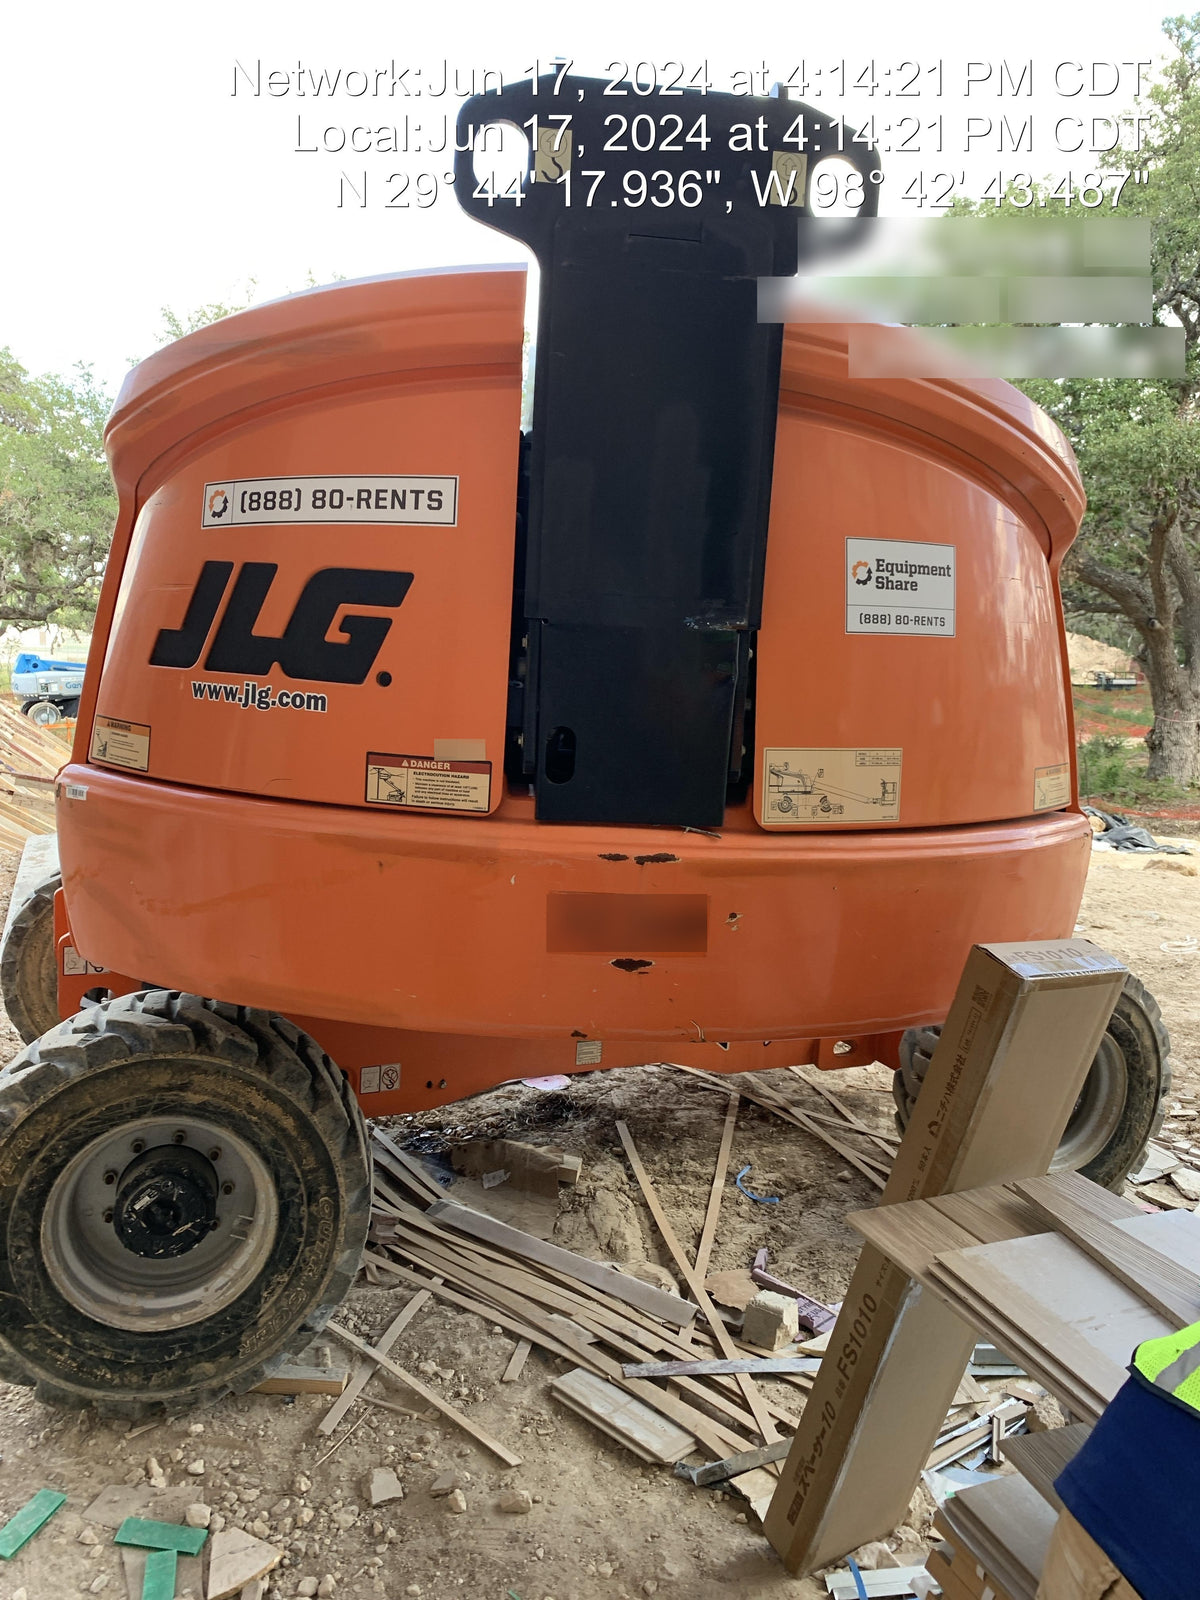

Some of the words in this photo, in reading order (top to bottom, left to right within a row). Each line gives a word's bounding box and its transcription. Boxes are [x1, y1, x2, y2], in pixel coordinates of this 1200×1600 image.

[240, 487, 302, 513] (888)
[311, 488, 444, 511] 80-RENTS
[875, 558, 952, 577] Equipment
[875, 576, 918, 591] Share
[149, 560, 415, 685] JLG
[859, 612, 891, 626] (888)
[895, 615, 946, 627] 80-RENTS
[191, 681, 328, 712] www.jlg.com
[410, 760, 451, 770] DANGER
[1014, 948, 1083, 962] FS1010
[836, 1293, 878, 1382] FS1010
